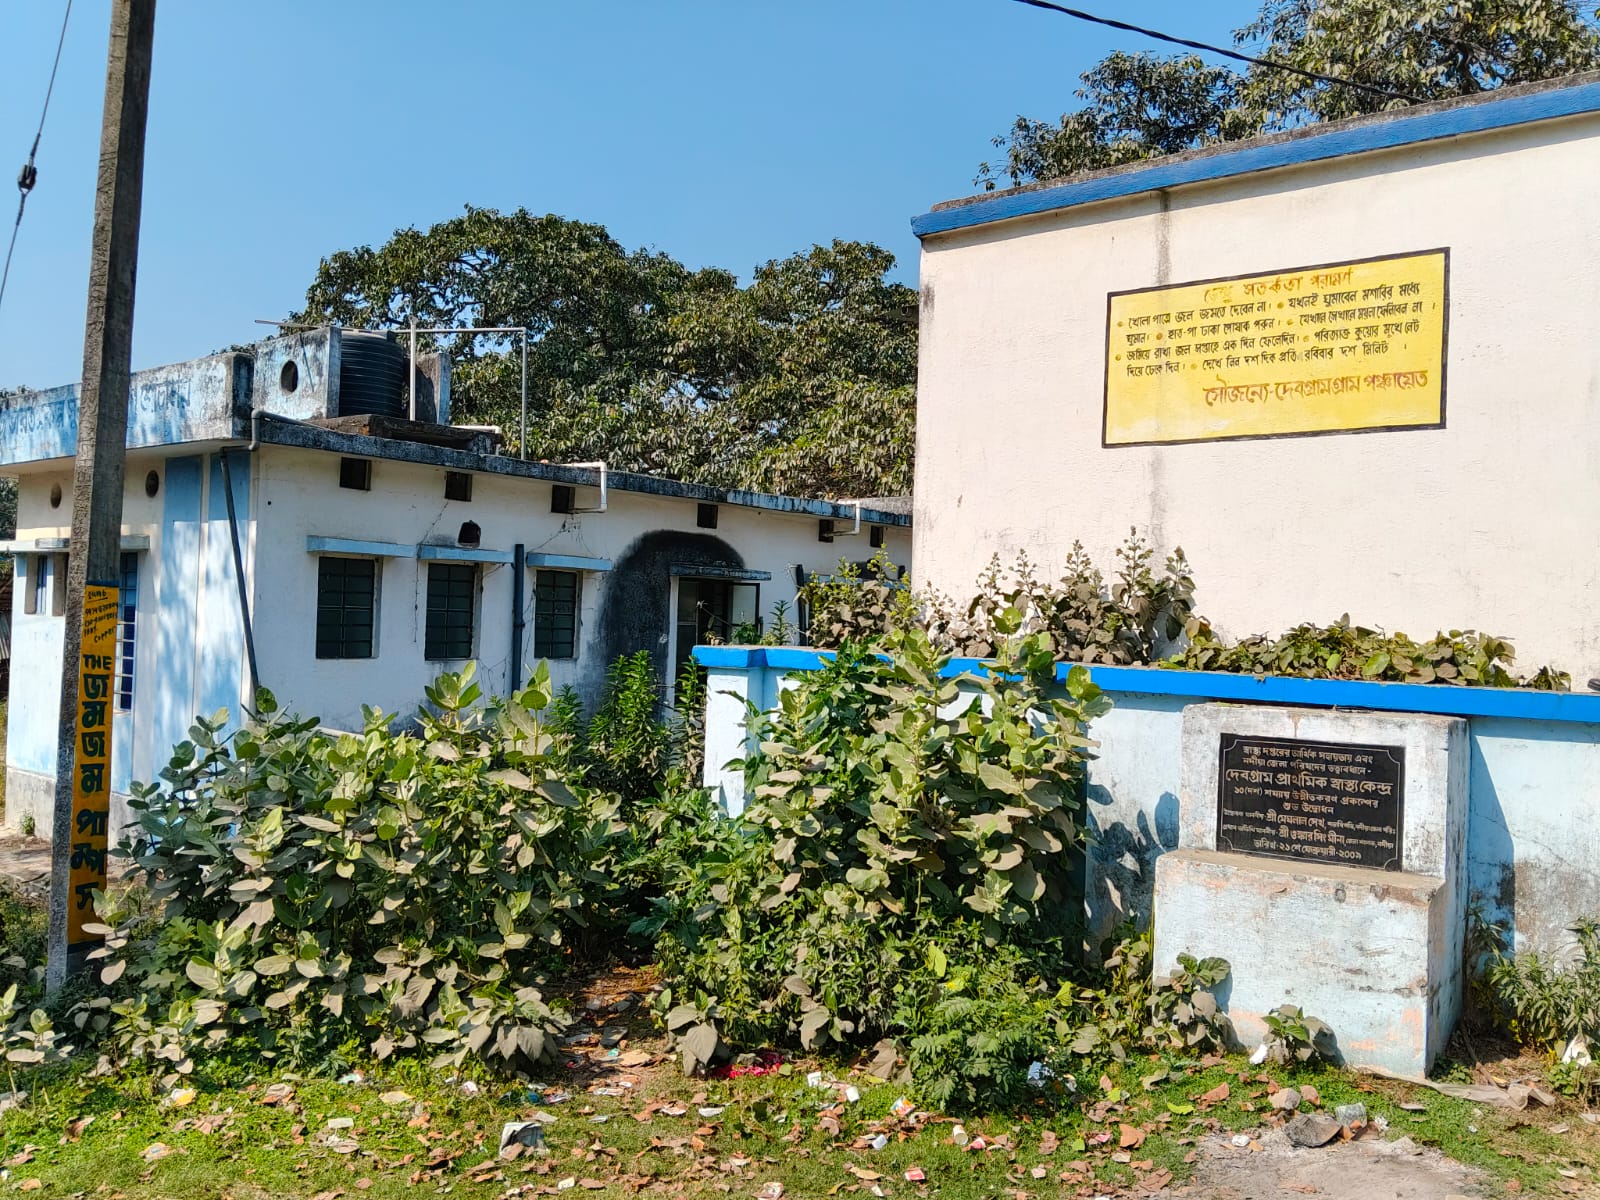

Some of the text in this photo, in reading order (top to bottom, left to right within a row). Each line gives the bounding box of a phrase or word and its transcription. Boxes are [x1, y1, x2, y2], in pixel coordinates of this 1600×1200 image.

[1128, 316, 1150, 329] খোলা
[1153, 313, 1170, 325] পাত্রে
[1175, 310, 1194, 323] জল
[1200, 307, 1226, 320] জমতে
[1230, 304, 1253, 317] দেবেন
[1289, 293, 1319, 309] যখনই
[1323, 290, 1358, 308] ঘুমাবেন
[1362, 284, 1394, 301] মশারির
[1399, 282, 1420, 297] মধ্যে
[1200, 324, 1221, 336] ঢাকা
[1412, 301, 1423, 314] না
[1154, 348, 1171, 360] রাখা
[1175, 344, 1191, 356] জল
[1223, 339, 1237, 351] এক
[1241, 336, 1255, 349] দিন
[1405, 319, 1420, 334] নেট
[1203, 358, 1222, 370] দেখে
[1244, 354, 1259, 366] দশ
[1261, 351, 1276, 364] দিক
[1279, 347, 1297, 363] প্রতি
[1304, 346, 1334, 361] রবিবার
[1339, 345, 1357, 357] দশ
[1363, 341, 1390, 356] মিনিট
[83, 654, 112, 671] THE
[1355, 754, 1373, 764] এবং
[1226, 769, 1273, 785] দেবগ্রাম
[1275, 771, 1328, 789] প্রাথমিক
